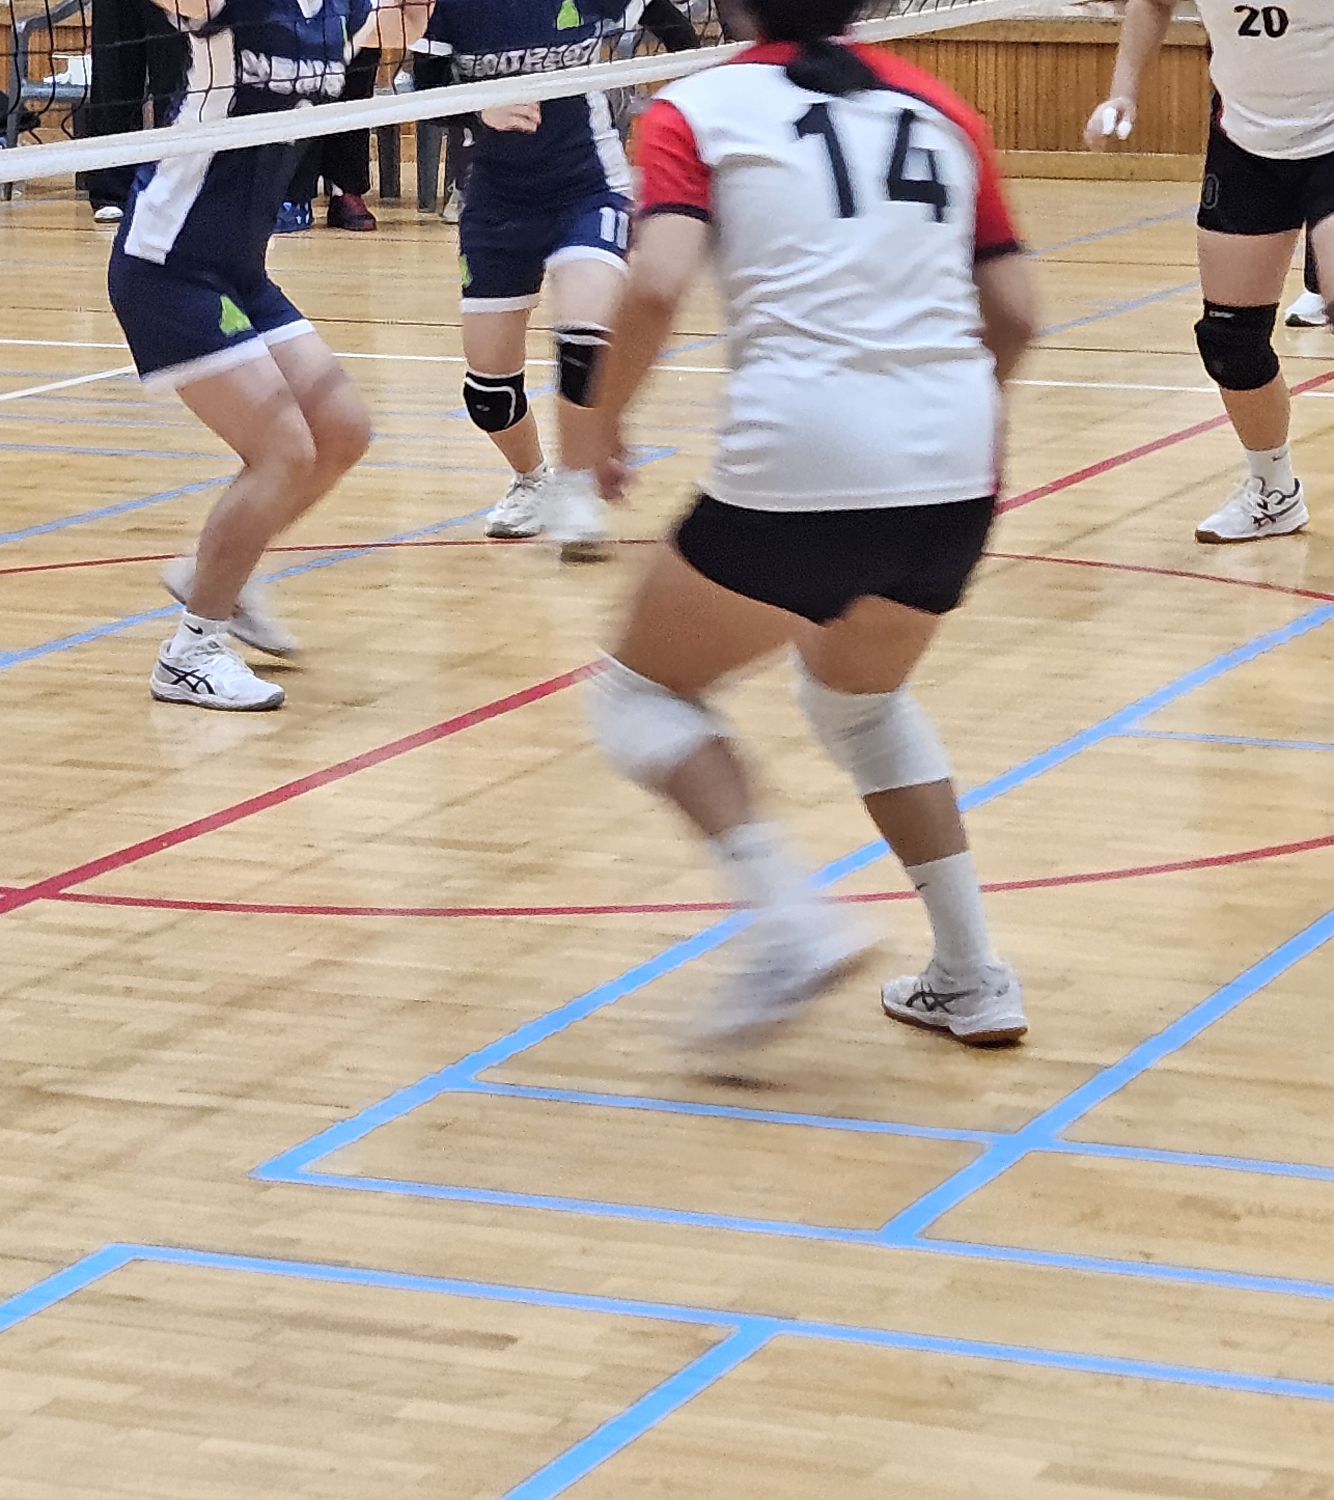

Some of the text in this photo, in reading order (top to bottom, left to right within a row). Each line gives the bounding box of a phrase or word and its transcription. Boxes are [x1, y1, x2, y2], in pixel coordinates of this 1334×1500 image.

[1233, 4, 1290, 38] 20
[793, 101, 951, 224] 14
[599, 206, 629, 243] 11
